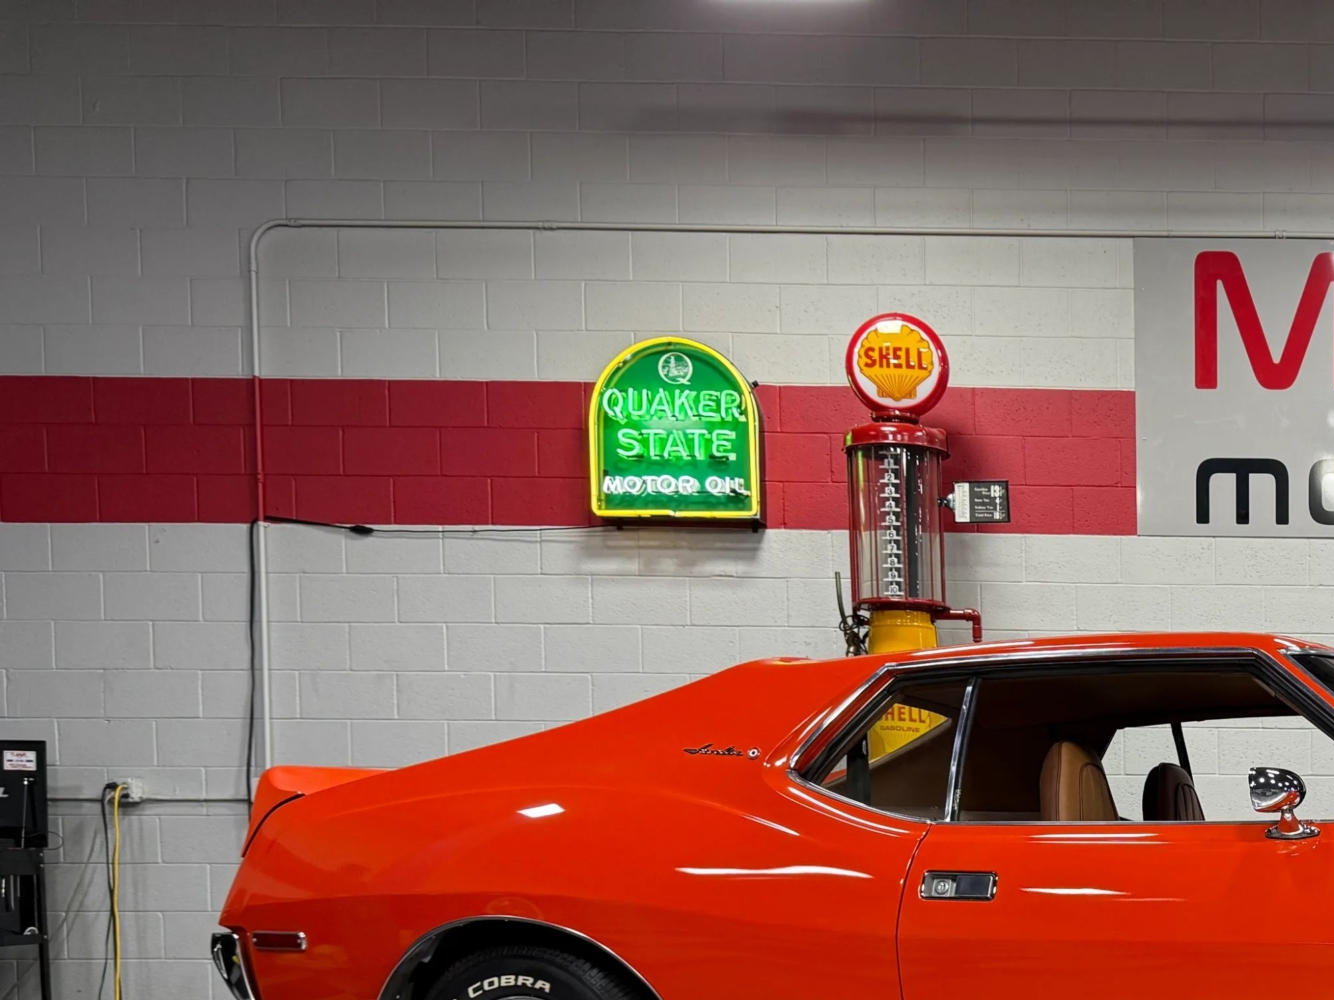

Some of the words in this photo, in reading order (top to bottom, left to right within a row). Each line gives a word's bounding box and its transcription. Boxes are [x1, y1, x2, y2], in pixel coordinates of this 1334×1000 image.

[863, 346, 928, 371] SHELL
[602, 387, 747, 425] QUAKER
[616, 428, 737, 461] STATE
[602, 474, 701, 496] MOTOR
[704, 475, 751, 496] OIL
[883, 705, 926, 724] HELL
[879, 724, 920, 733] GASOLINE
[467, 974, 551, 999] COBRA
